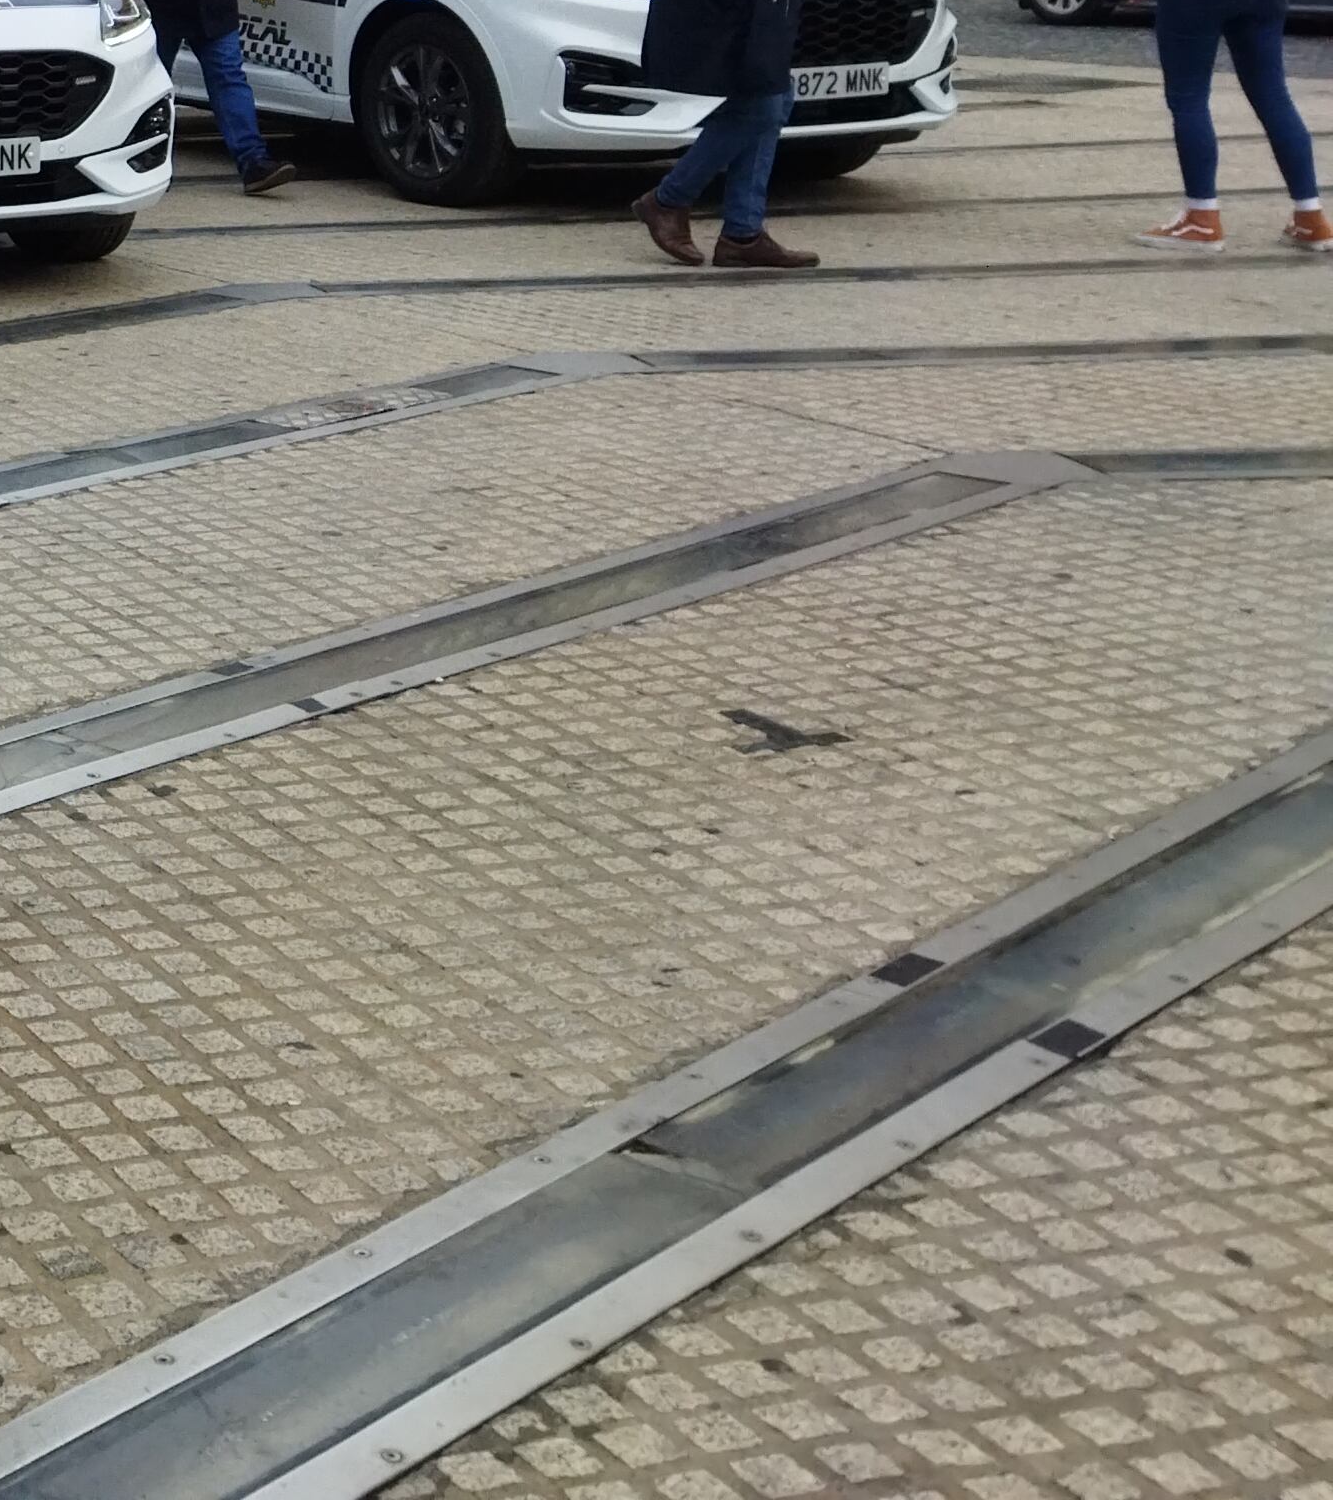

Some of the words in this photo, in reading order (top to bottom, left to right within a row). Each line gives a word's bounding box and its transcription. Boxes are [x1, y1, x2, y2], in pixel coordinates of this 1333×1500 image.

[239, 13, 292, 46] OCAL
[790, 71, 839, 97] 872
[846, 67, 884, 93] MNK
